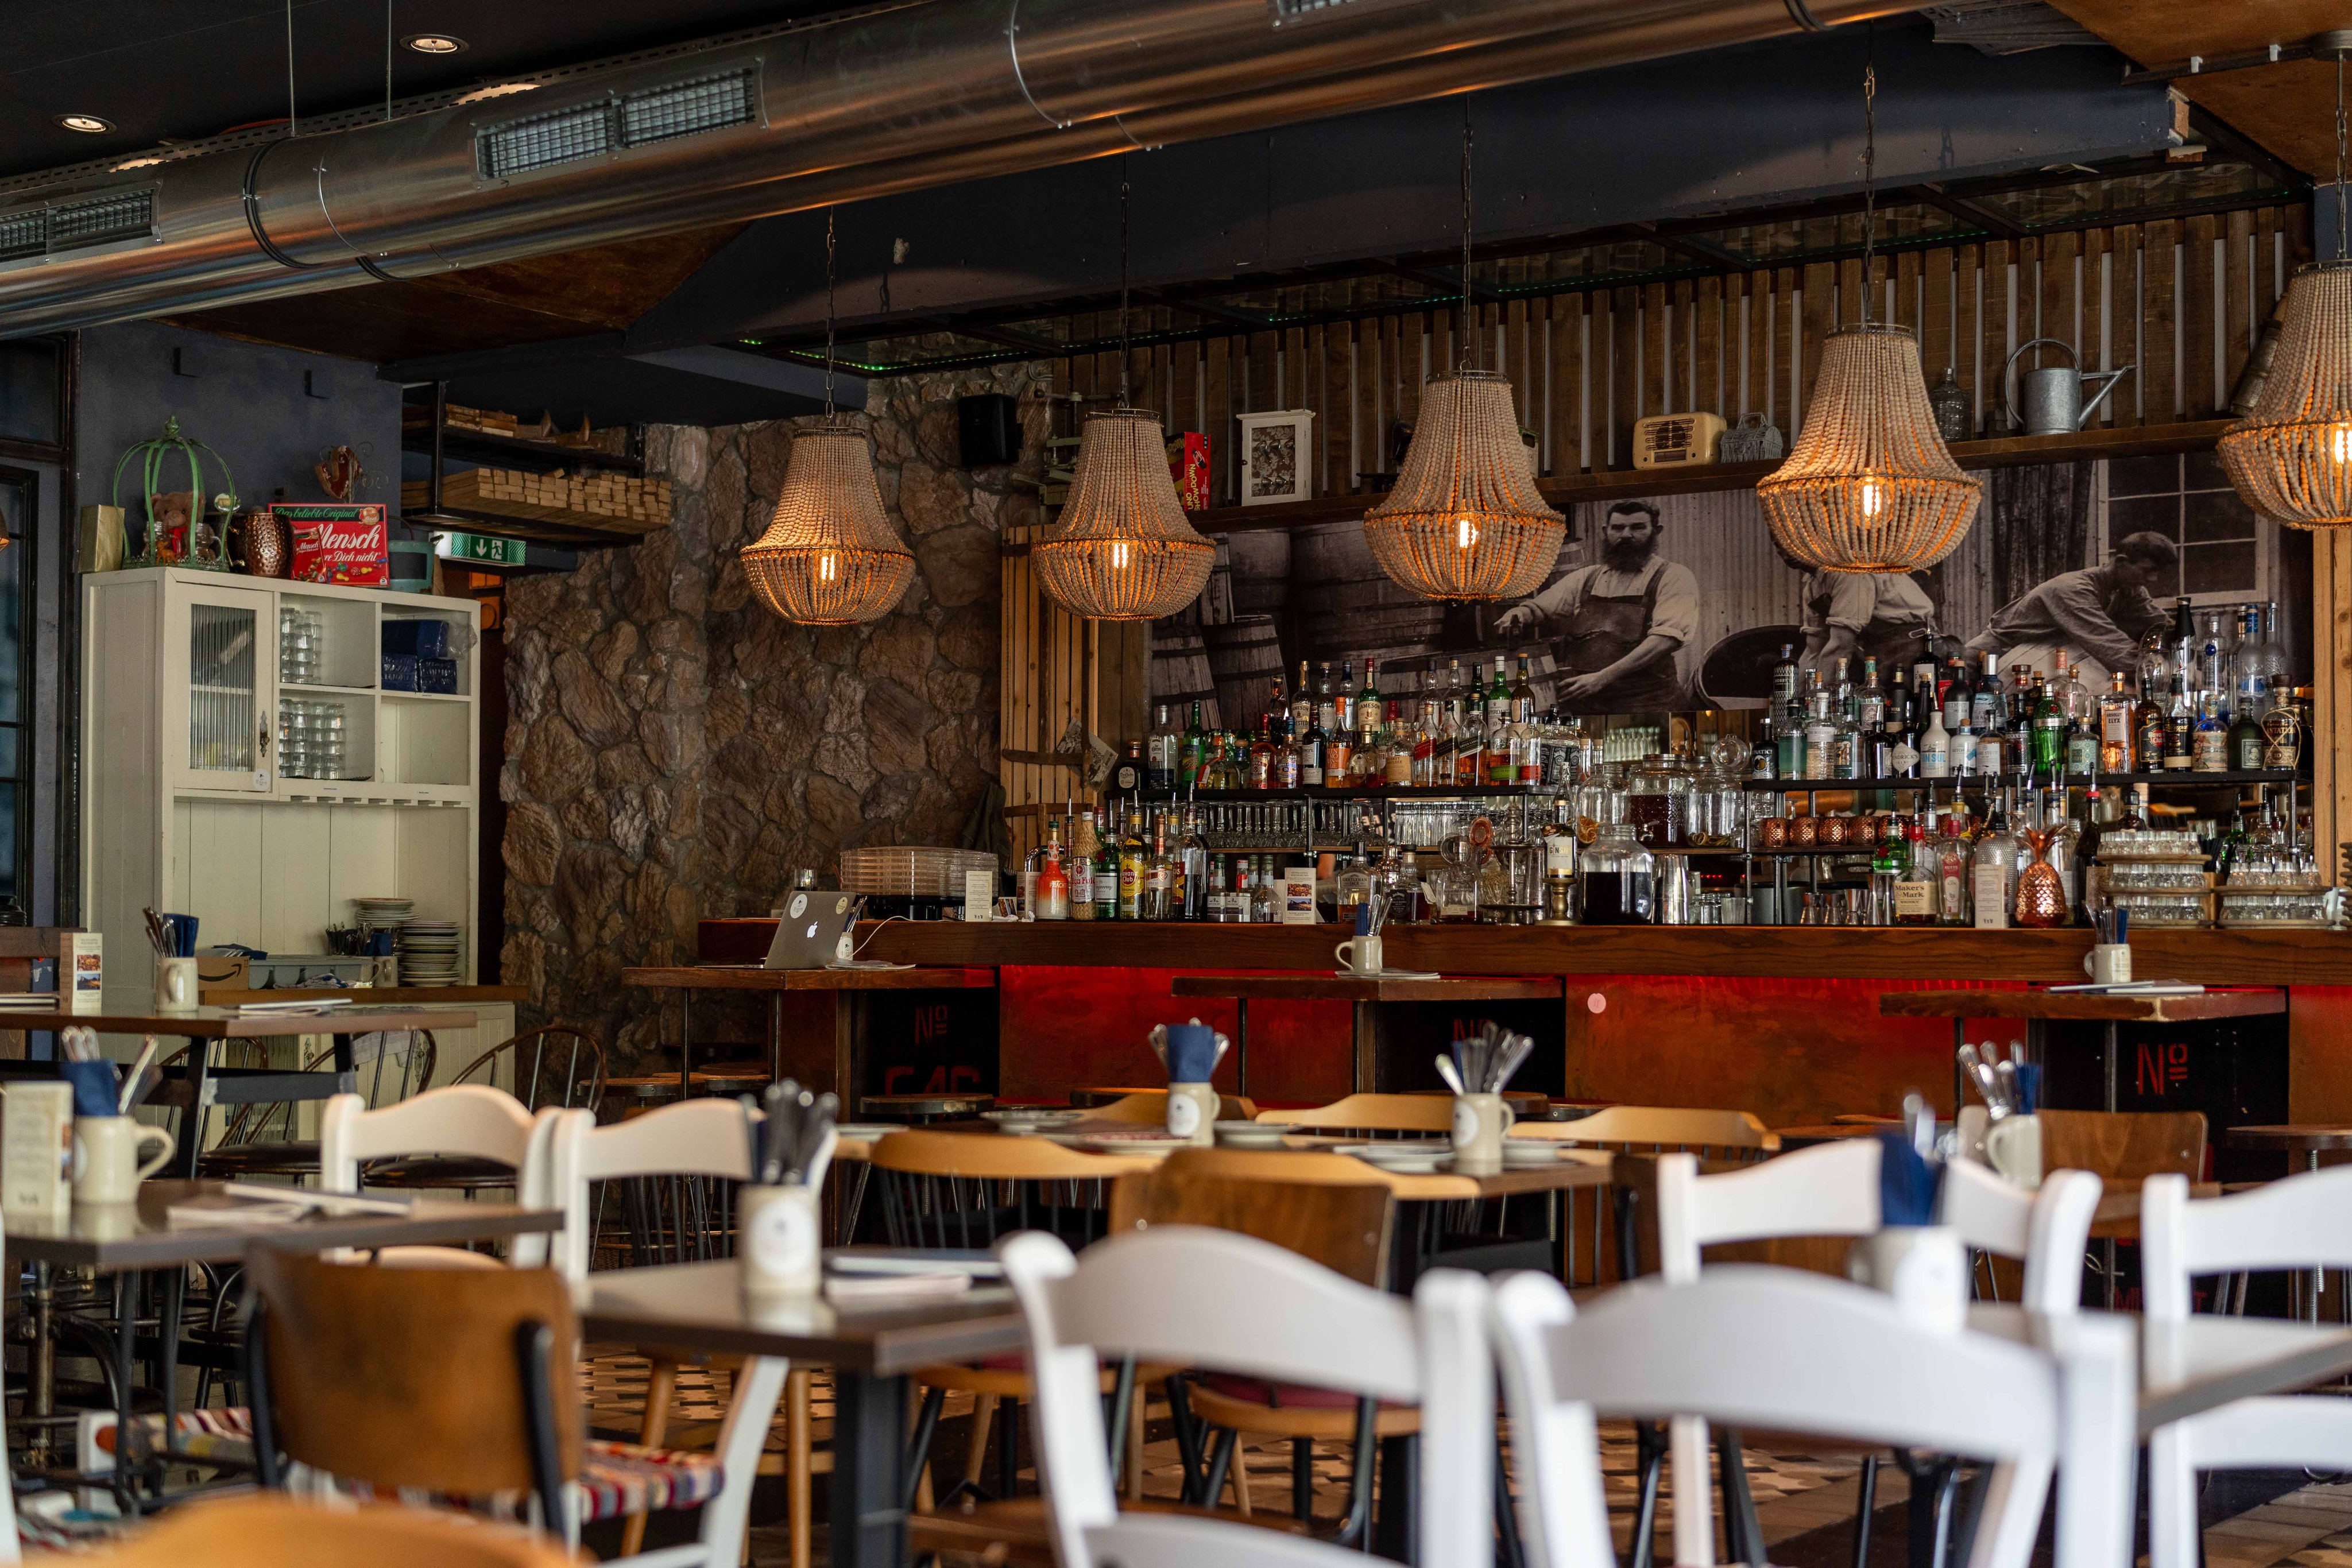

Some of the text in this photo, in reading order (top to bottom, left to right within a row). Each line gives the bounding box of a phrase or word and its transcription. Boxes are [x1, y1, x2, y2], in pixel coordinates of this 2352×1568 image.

[1189, 464, 1201, 511] SHOWDOWN
[293, 508, 323, 518] beliebte
[322, 508, 359, 521] Original
[334, 551, 355, 562] Dich
